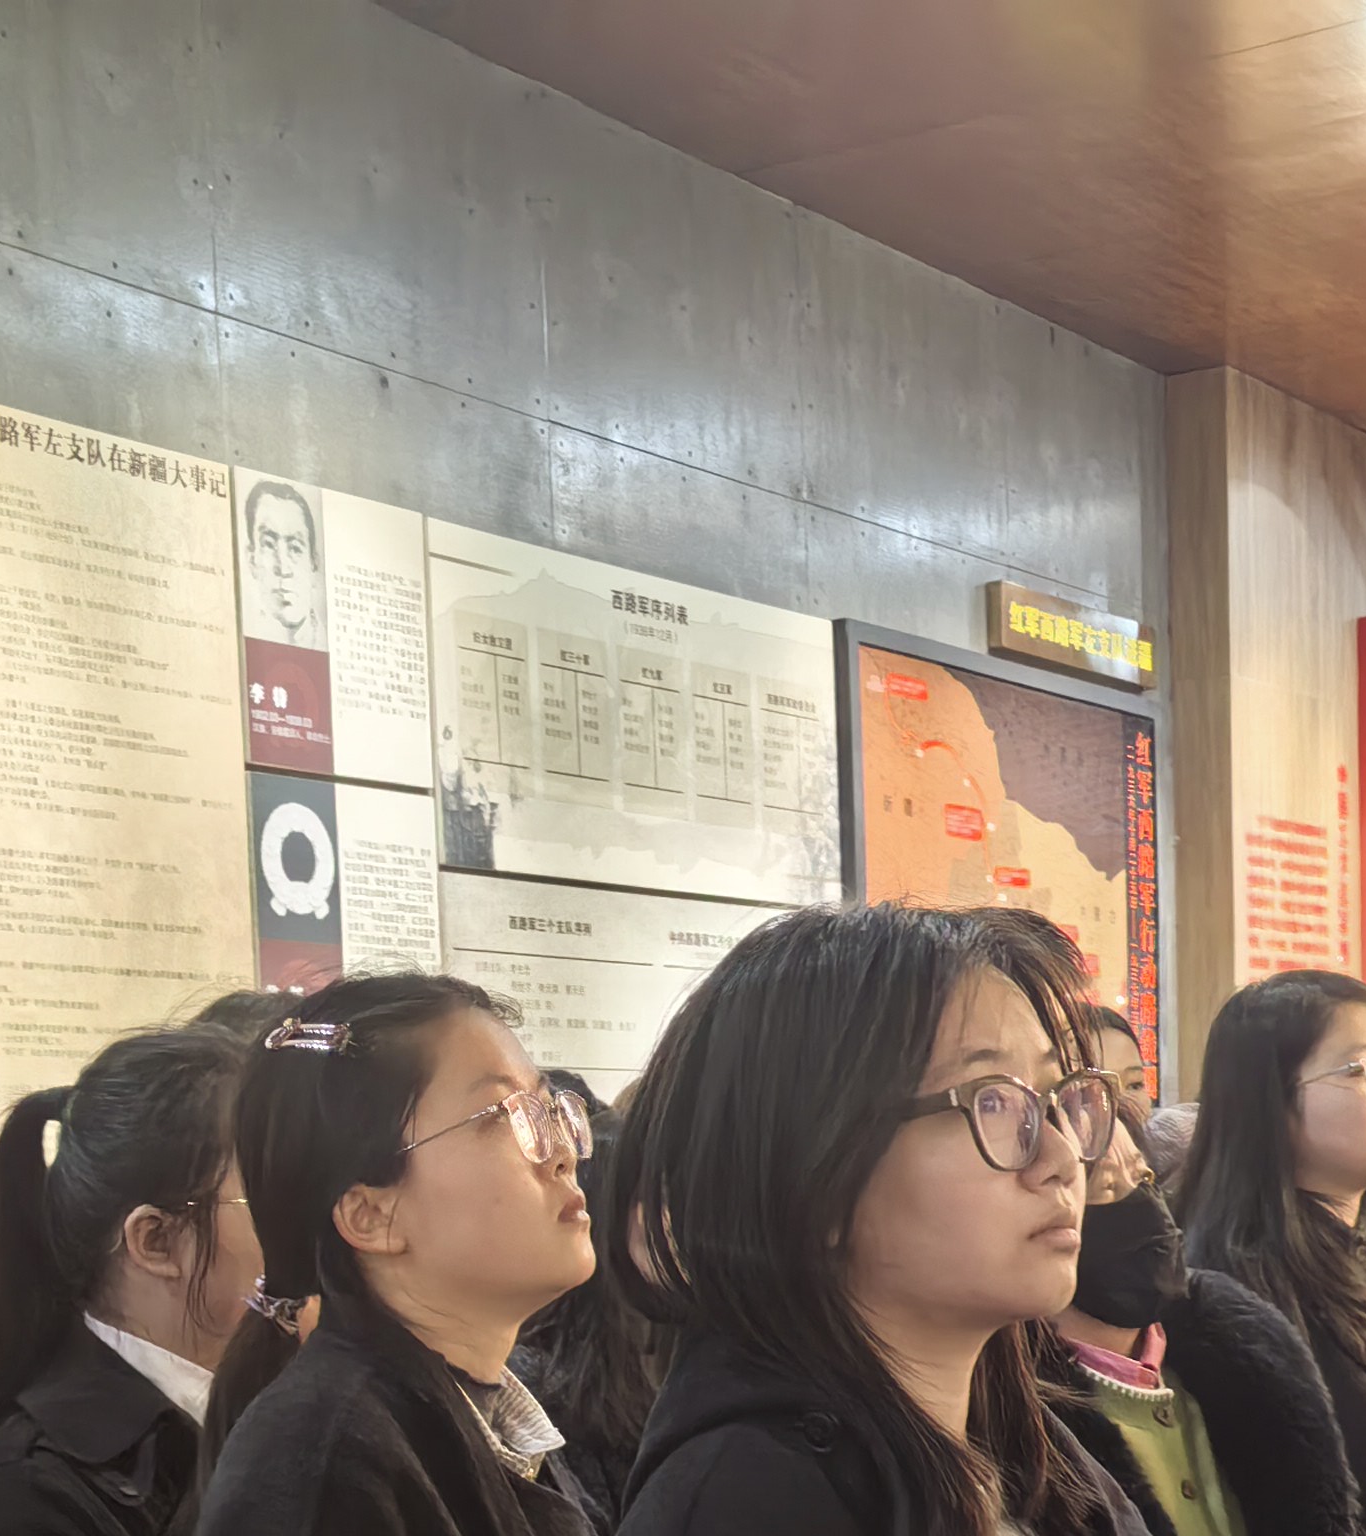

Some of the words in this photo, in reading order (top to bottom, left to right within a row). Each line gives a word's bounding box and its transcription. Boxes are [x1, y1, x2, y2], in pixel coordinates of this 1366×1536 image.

[610, 588, 689, 626] 西路军序列表
